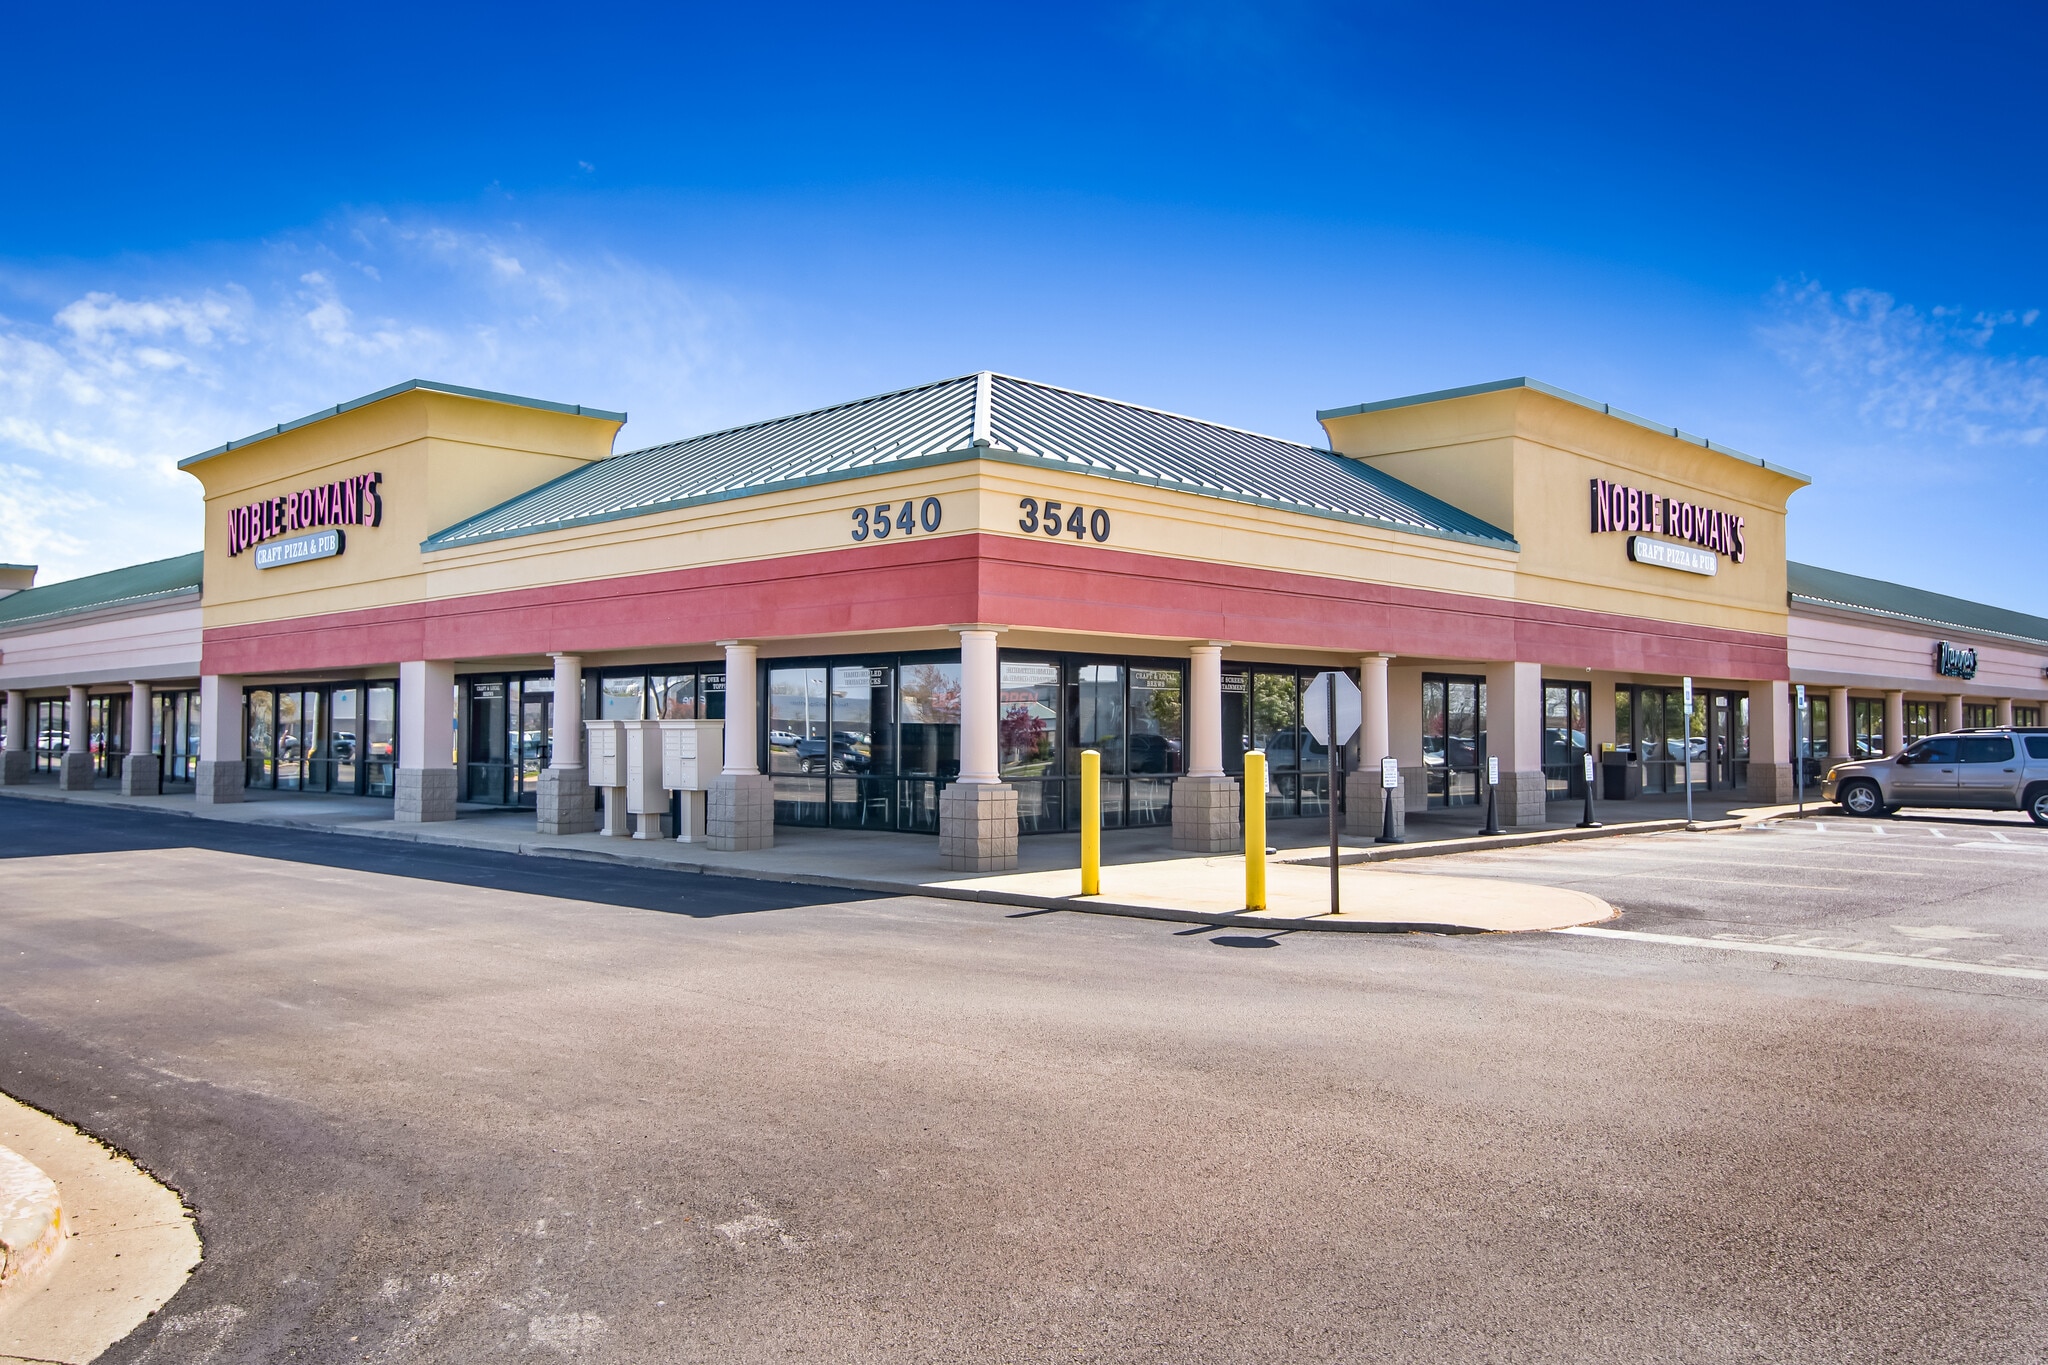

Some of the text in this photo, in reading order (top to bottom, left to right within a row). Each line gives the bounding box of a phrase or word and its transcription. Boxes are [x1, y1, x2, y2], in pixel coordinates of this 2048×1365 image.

[227, 472, 382, 558] NOBLE ROMAN'S
[851, 497, 942, 541] 3540
[1019, 498, 1111, 542] 3540
[1591, 478, 1745, 564] NOBLE ROMAN'S
[257, 535, 336, 564] CRAFT PIZZA & PUB
[1637, 541, 1715, 571] CRAFT PIZZA & PUB
[1135, 672, 1153, 680] CRAFT
[1146, 680, 1165, 688] BREWS
[1225, 676, 1245, 685] SCREEN
